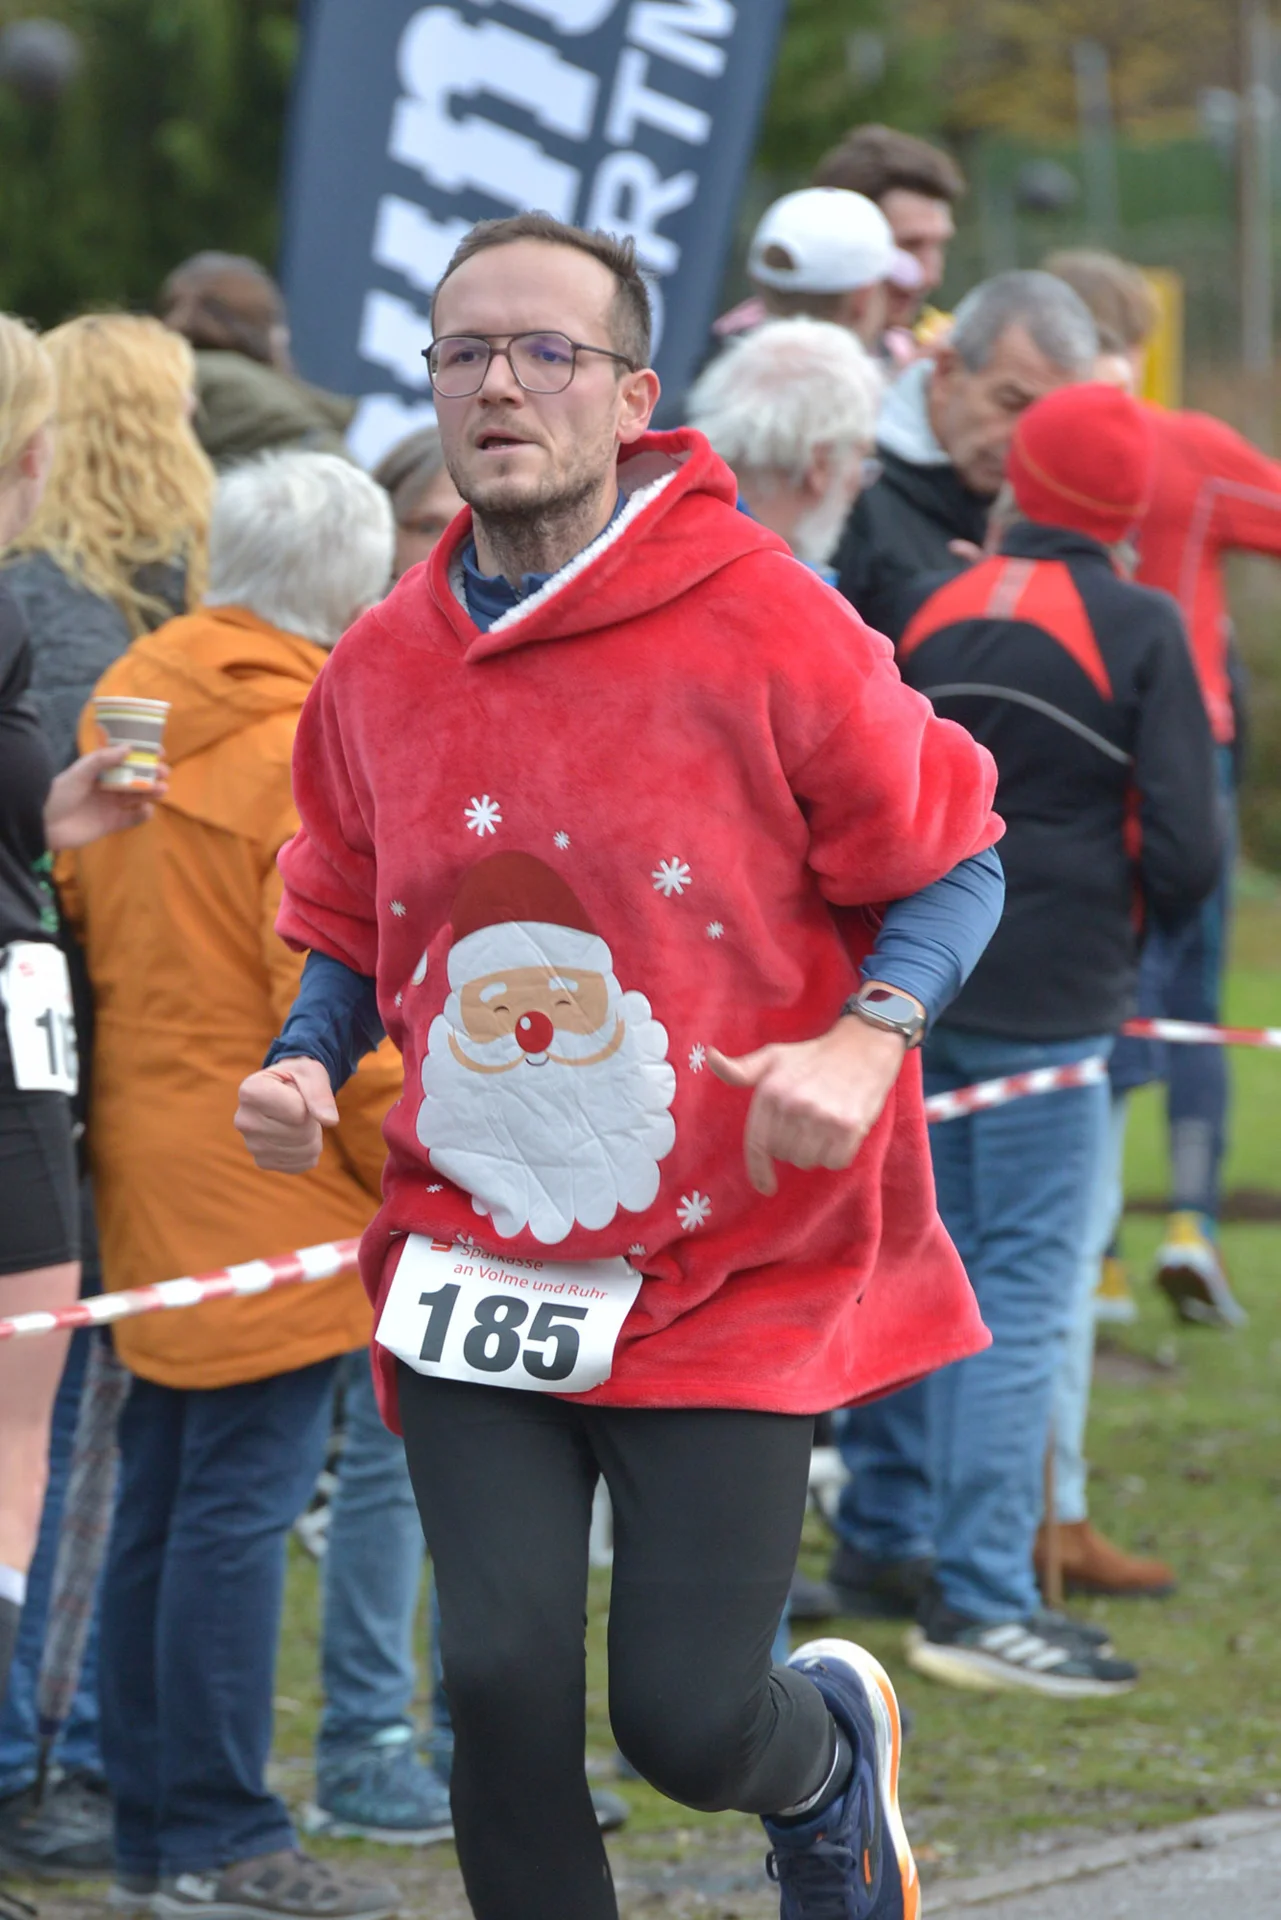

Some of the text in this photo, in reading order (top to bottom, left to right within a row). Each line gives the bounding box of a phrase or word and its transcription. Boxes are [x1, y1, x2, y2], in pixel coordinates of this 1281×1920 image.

[453, 1264, 608, 1300] an Volme und Ruhr
[418, 1282, 589, 1381] 185
